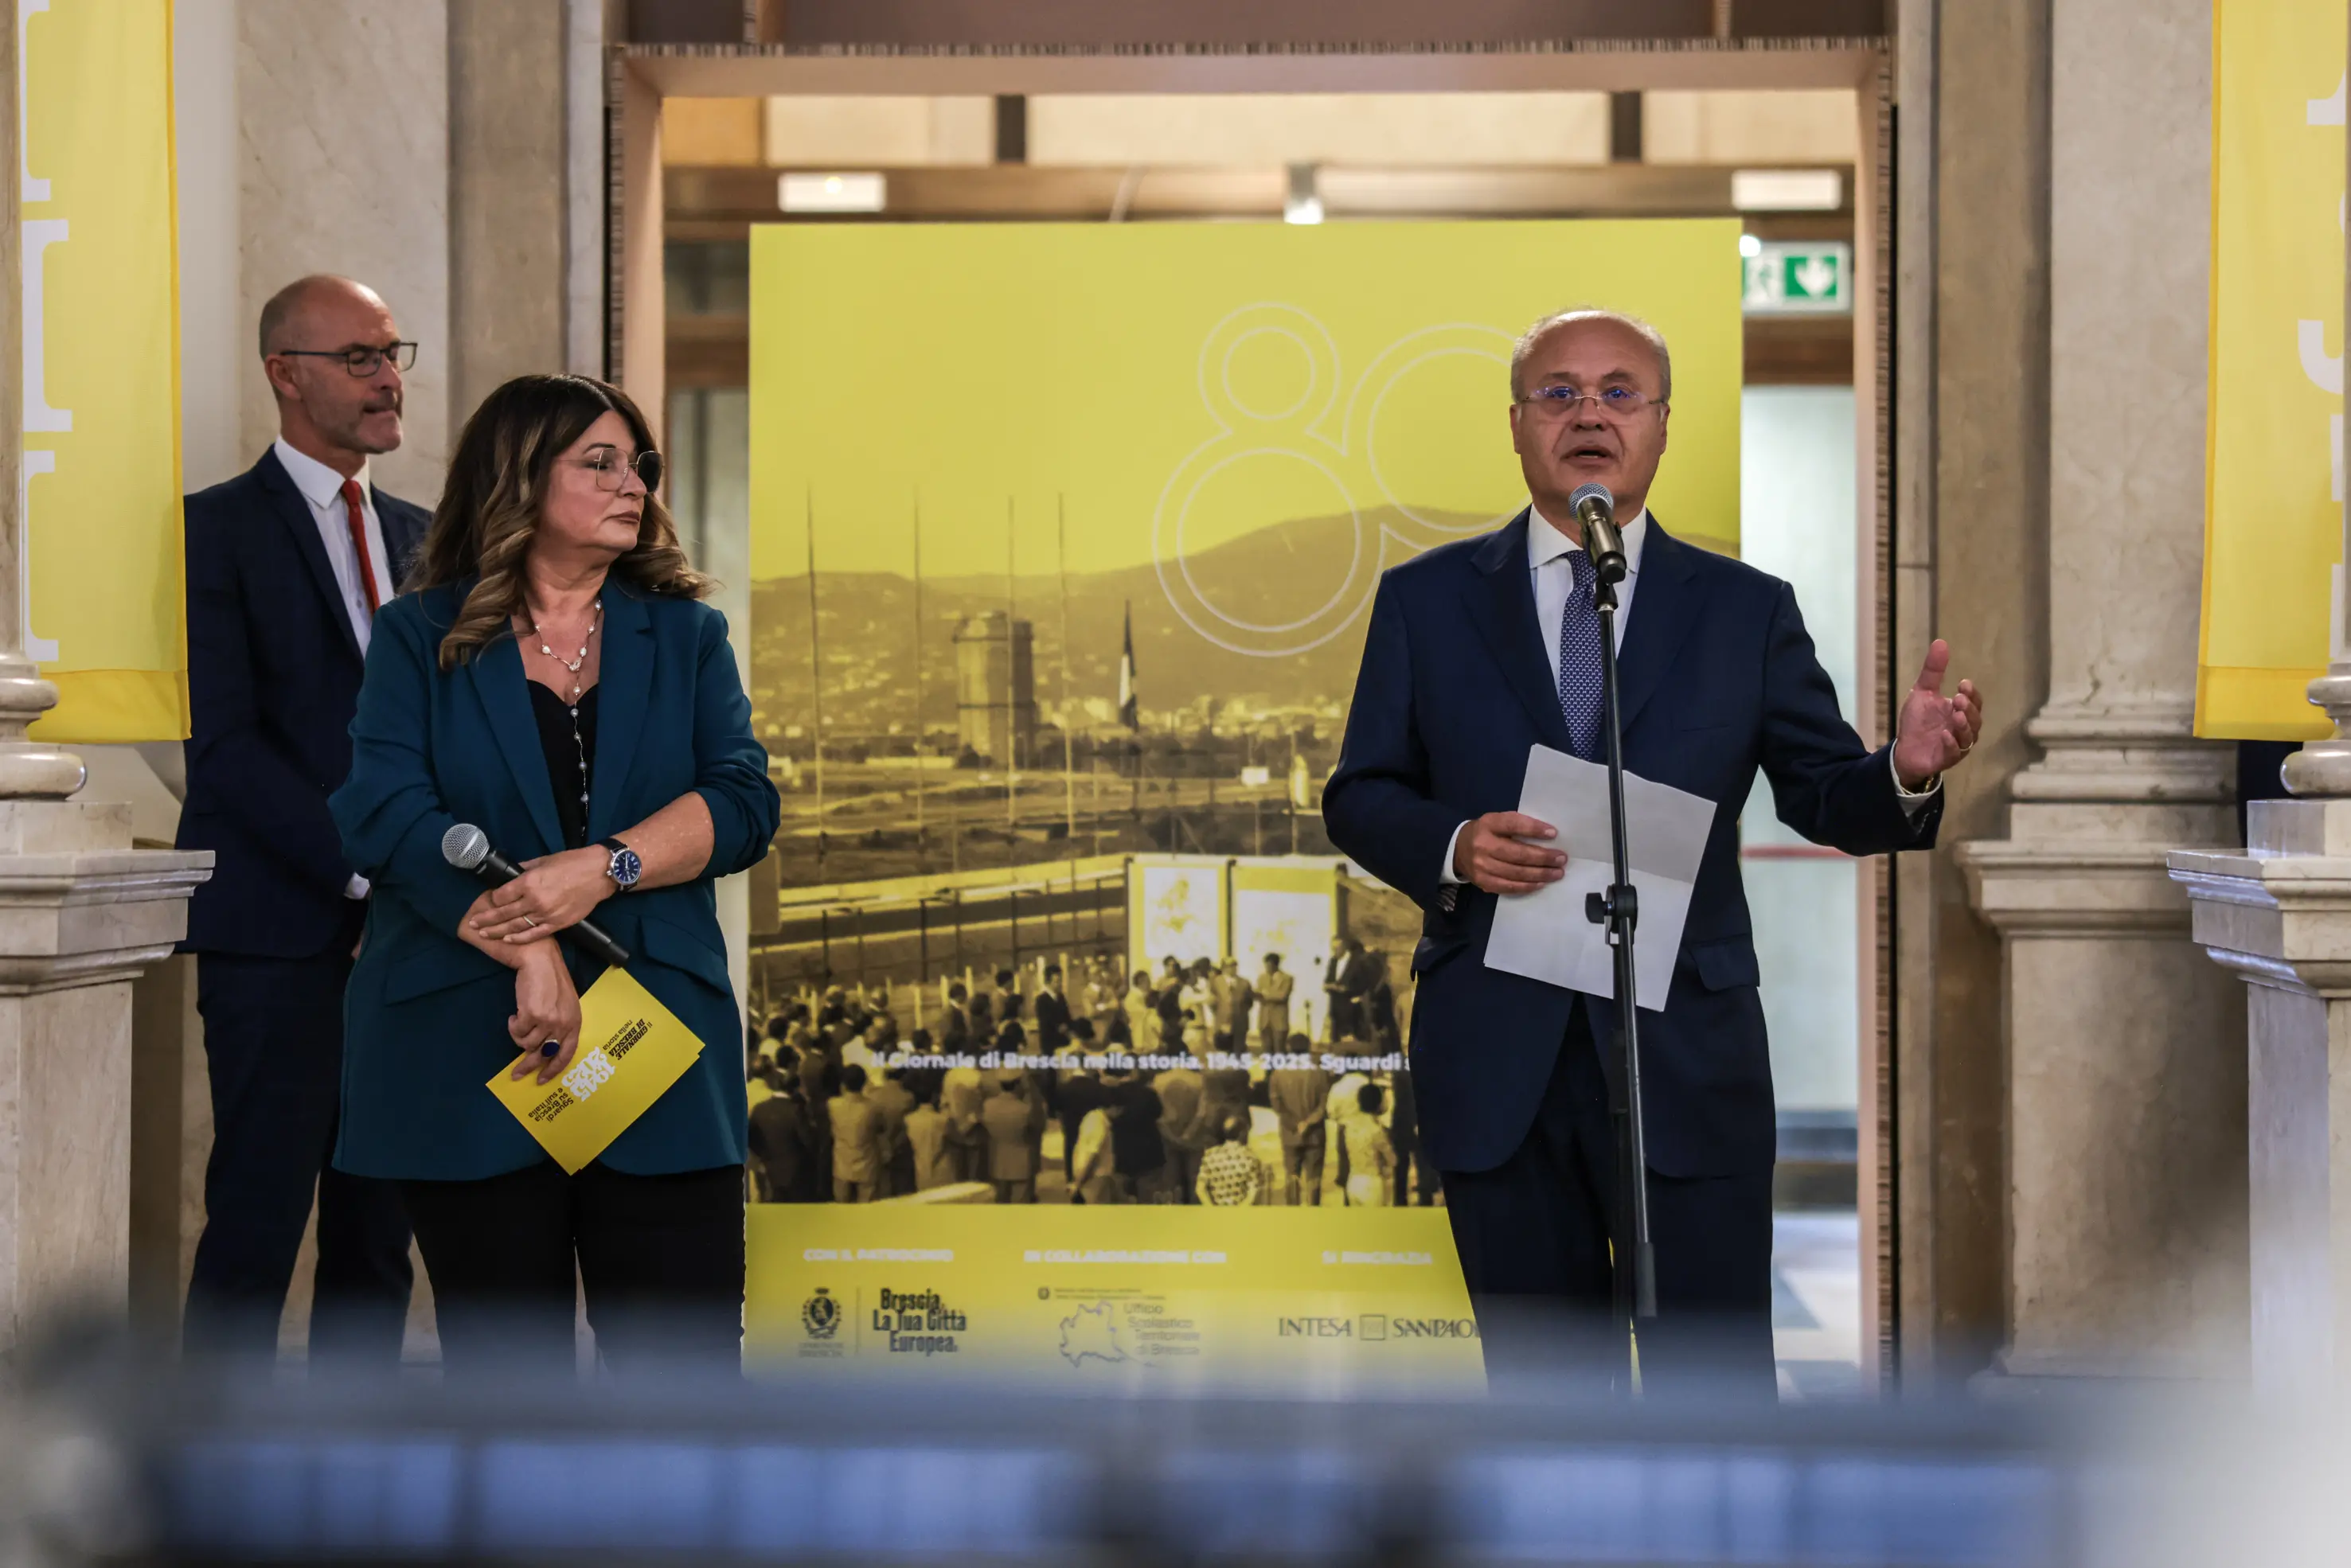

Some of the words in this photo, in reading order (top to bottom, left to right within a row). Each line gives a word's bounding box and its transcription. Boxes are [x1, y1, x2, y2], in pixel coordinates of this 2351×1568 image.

[617, 1020, 633, 1036] nella
[634, 1018, 646, 1030] DI
[603, 1033, 620, 1051] storia
[608, 1027, 638, 1058] BRESCIA
[616, 1025, 649, 1060] GIORNALE
[560, 1047, 608, 1088] 2025
[888, 1051, 976, 1069] Giornale
[979, 1051, 1000, 1069] di
[1003, 1051, 1079, 1070] Brescia
[1084, 1051, 1134, 1070] nella
[1138, 1051, 1202, 1071] storia.
[1319, 1052, 1401, 1075] Sguardi
[570, 1062, 615, 1102] 1945
[528, 1090, 559, 1118] sull'Italia
[558, 1091, 568, 1102] su
[534, 1099, 560, 1122] Brescia
[545, 1097, 574, 1123] Sguardi
[873, 1309, 891, 1331] La
[1279, 1316, 1352, 1338] INTESA
[889, 1330, 959, 1356] Europea.
